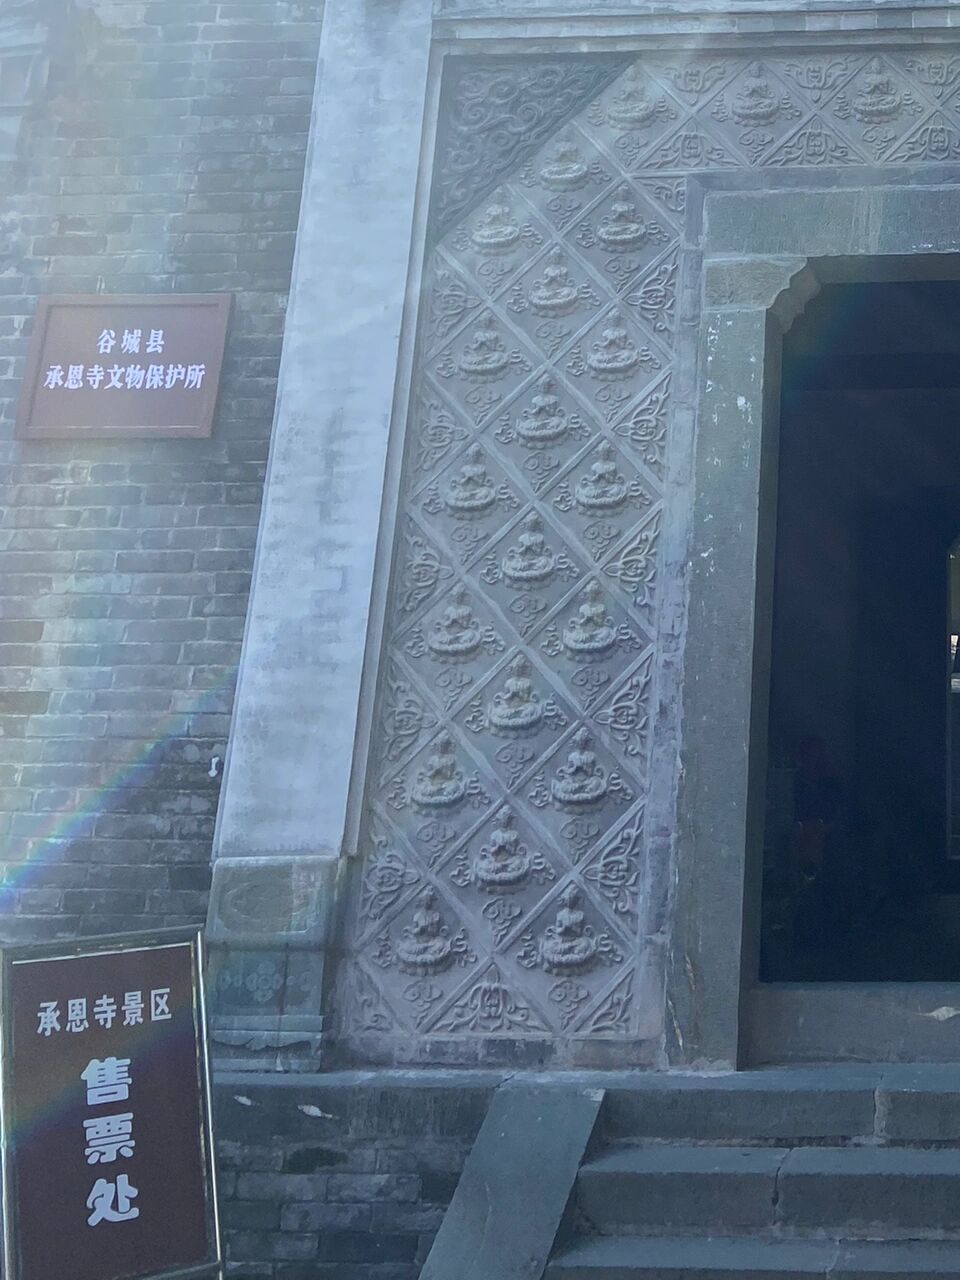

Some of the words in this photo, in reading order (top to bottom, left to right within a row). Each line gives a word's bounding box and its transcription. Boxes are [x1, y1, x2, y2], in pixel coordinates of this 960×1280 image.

[97, 329, 165, 354] 谷城县
[43, 364, 206, 390] 承恩寺文物保护所
[36, 987, 173, 1037] 承恩寺景区
[80, 1056, 140, 1228] 售票处
